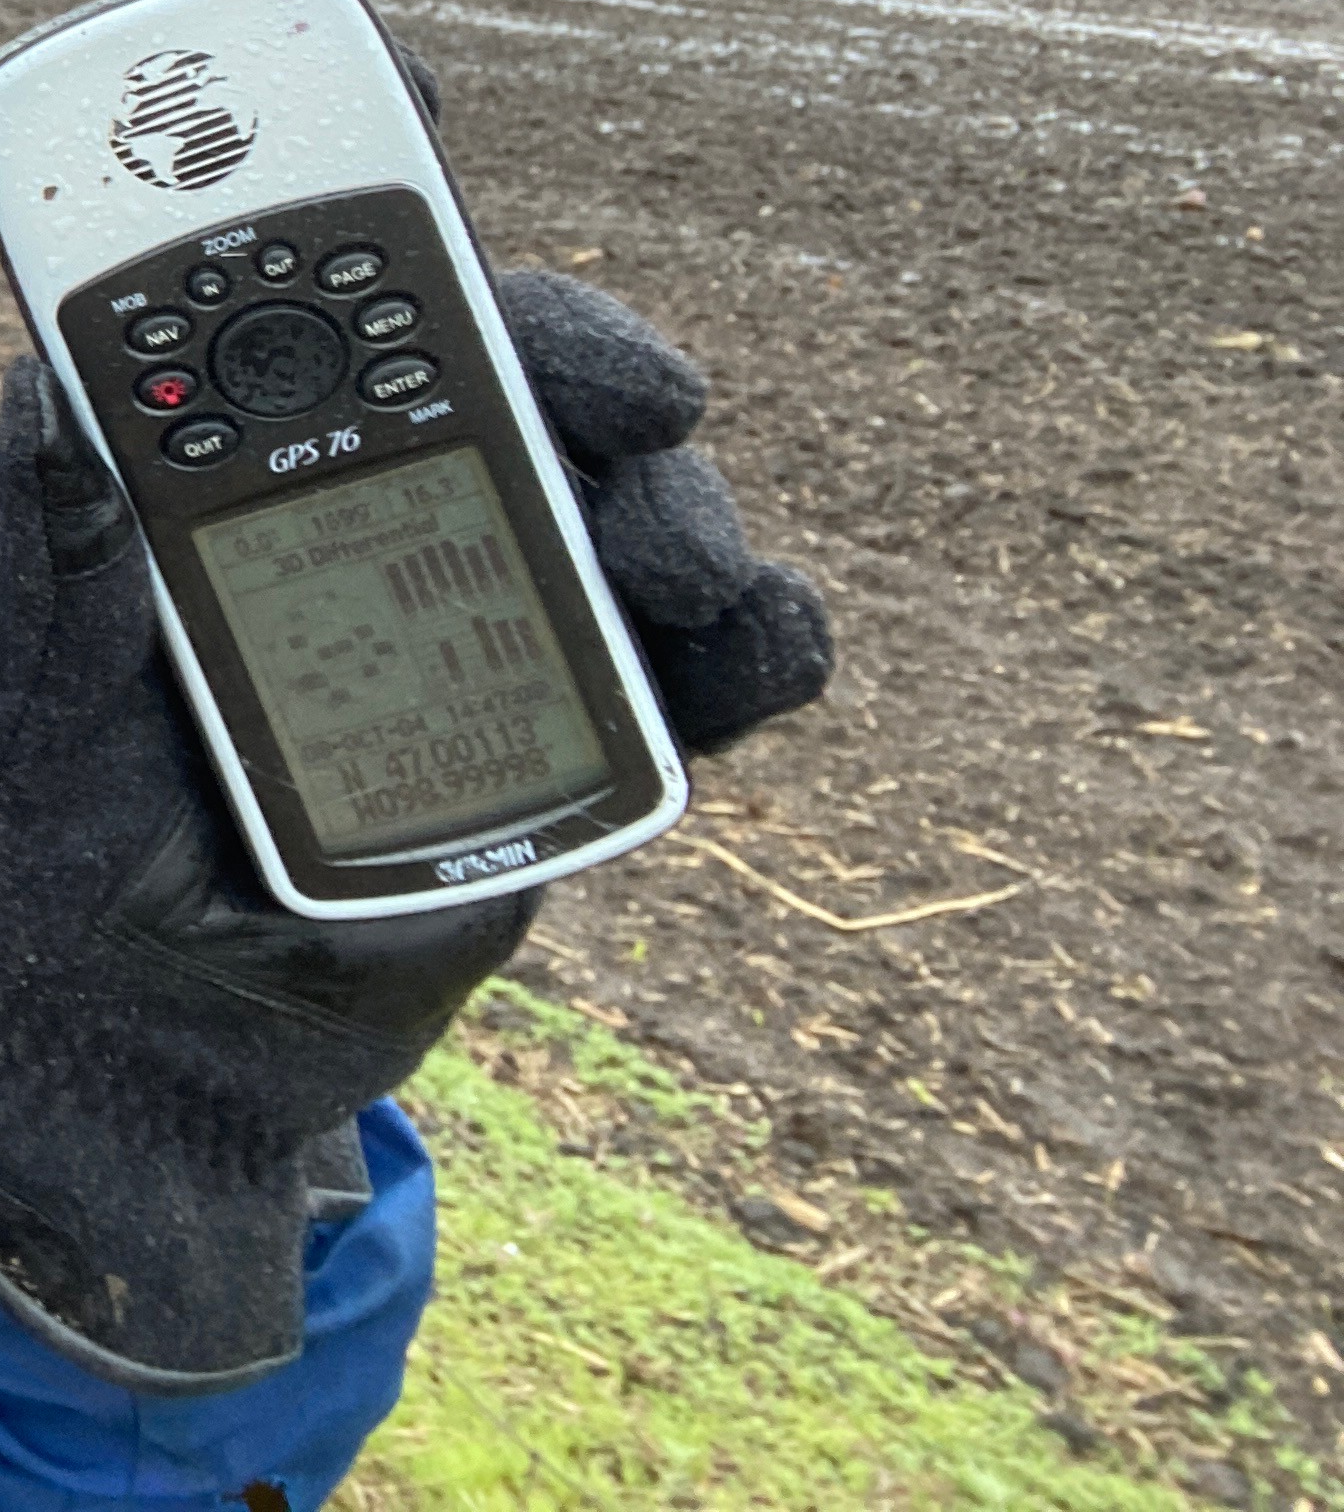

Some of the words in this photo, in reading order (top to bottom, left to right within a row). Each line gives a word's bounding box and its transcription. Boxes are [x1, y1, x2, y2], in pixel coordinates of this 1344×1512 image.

[201, 226, 258, 257] ZOOM
[264, 257, 293, 277] OUT
[330, 262, 377, 287] PAGE
[201, 283, 220, 297] IN
[111, 292, 148, 314] MOB
[145, 325, 179, 348] NAV
[365, 311, 413, 337] MENU
[373, 370, 430, 399] ENTER
[408, 399, 455, 424] MARK
[184, 435, 223, 458] QUIT
[269, 438, 320, 473] GPS
[326, 425, 361, 457] 76
